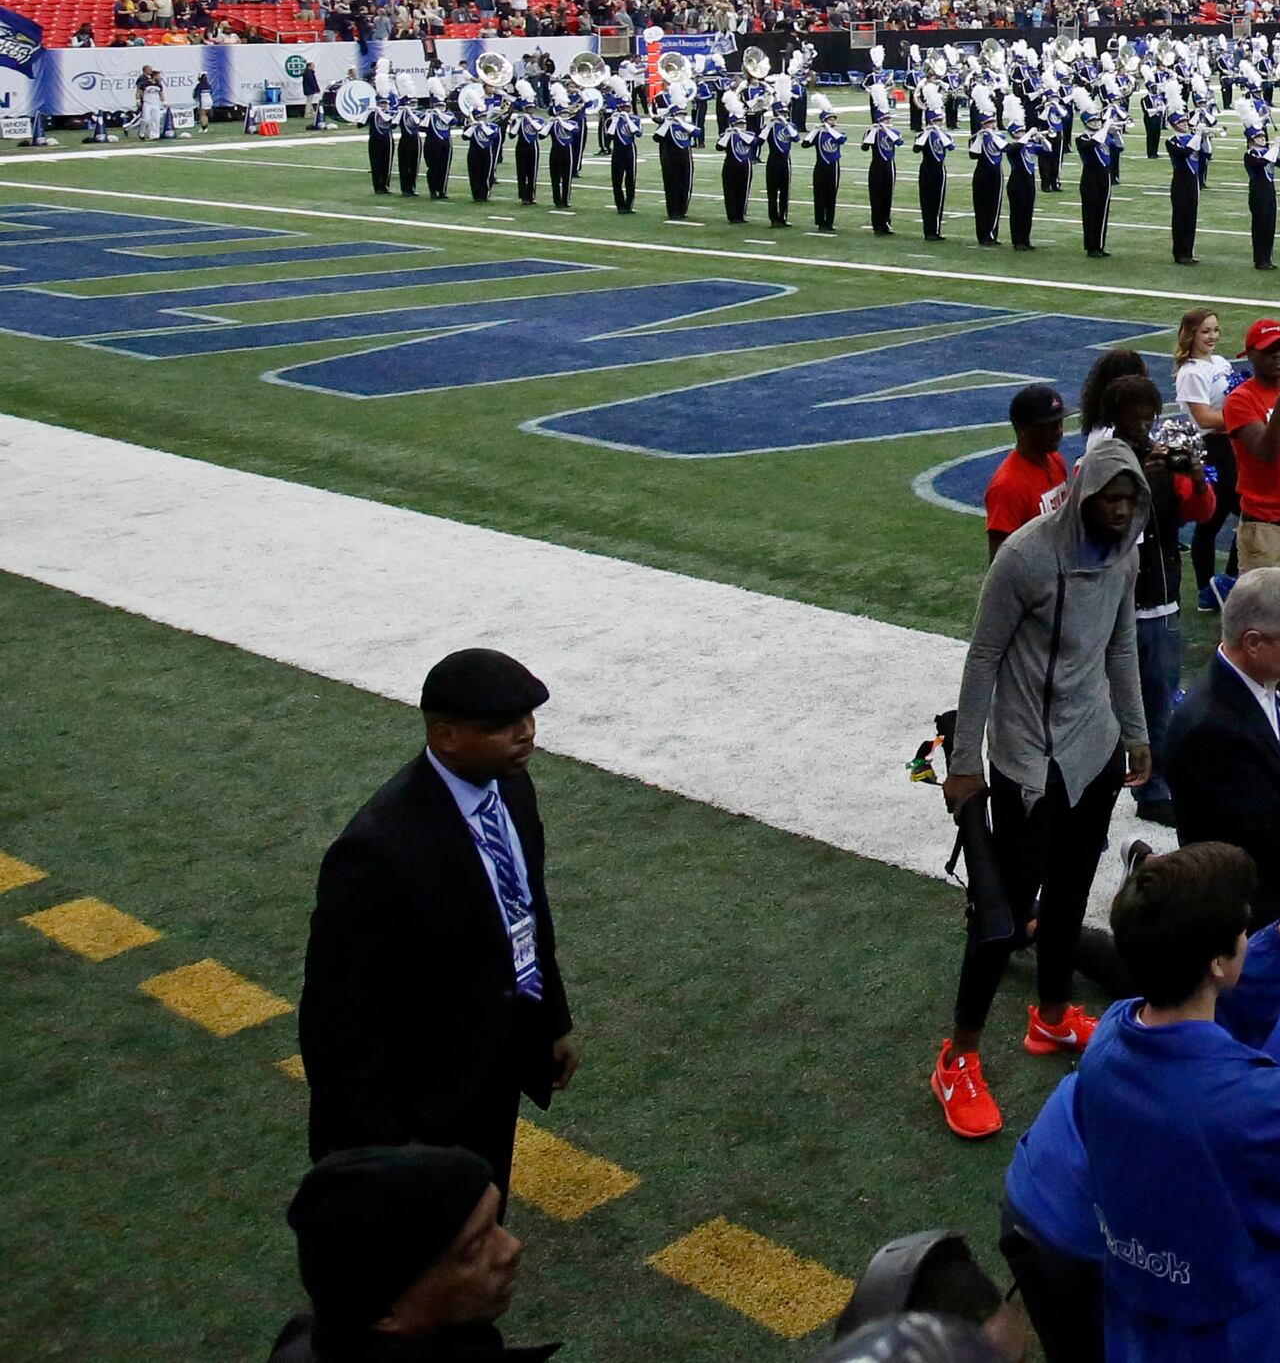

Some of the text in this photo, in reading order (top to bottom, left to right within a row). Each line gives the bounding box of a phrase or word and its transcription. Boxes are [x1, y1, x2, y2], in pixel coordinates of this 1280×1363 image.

[100, 79, 124, 91] EYE
[3, 117, 30, 128] WHOSE
[4, 126, 30, 136] HOUSE
